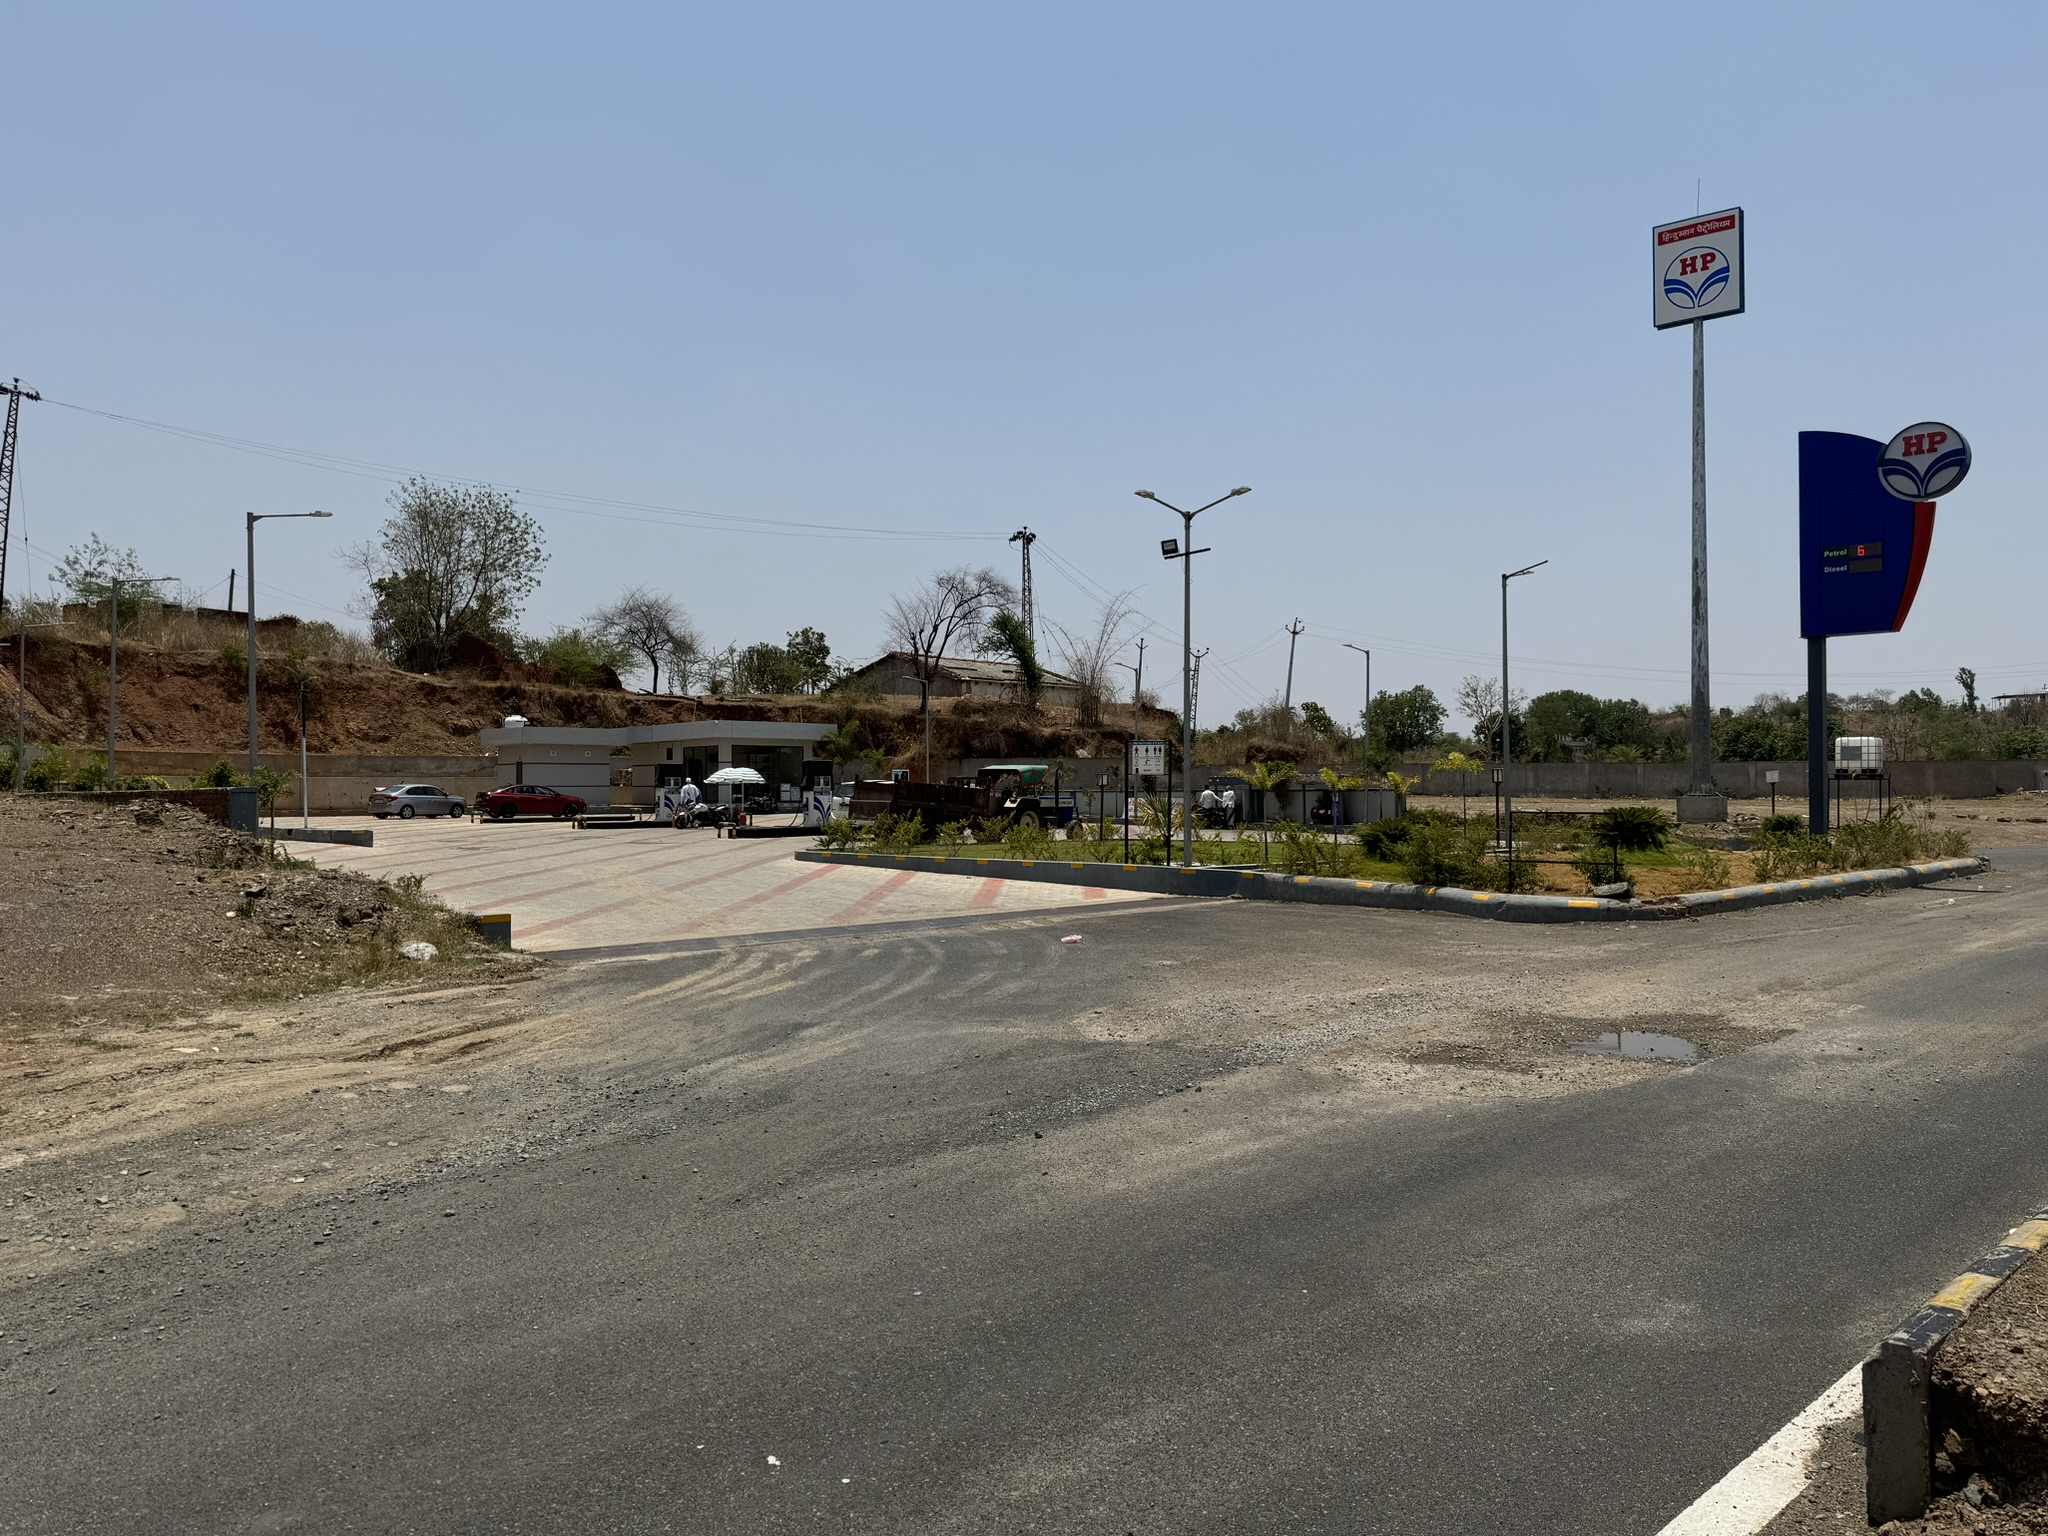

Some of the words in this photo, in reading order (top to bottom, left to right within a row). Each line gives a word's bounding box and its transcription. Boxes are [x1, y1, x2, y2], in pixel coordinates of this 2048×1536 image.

[1696, 220, 1731, 233] पेट्रोलियम
[1680, 252, 1716, 276] HP
[1902, 431, 1947, 457] HP
[1823, 548, 1848, 558] Petrol
[1823, 564, 1848, 573] Diesel
